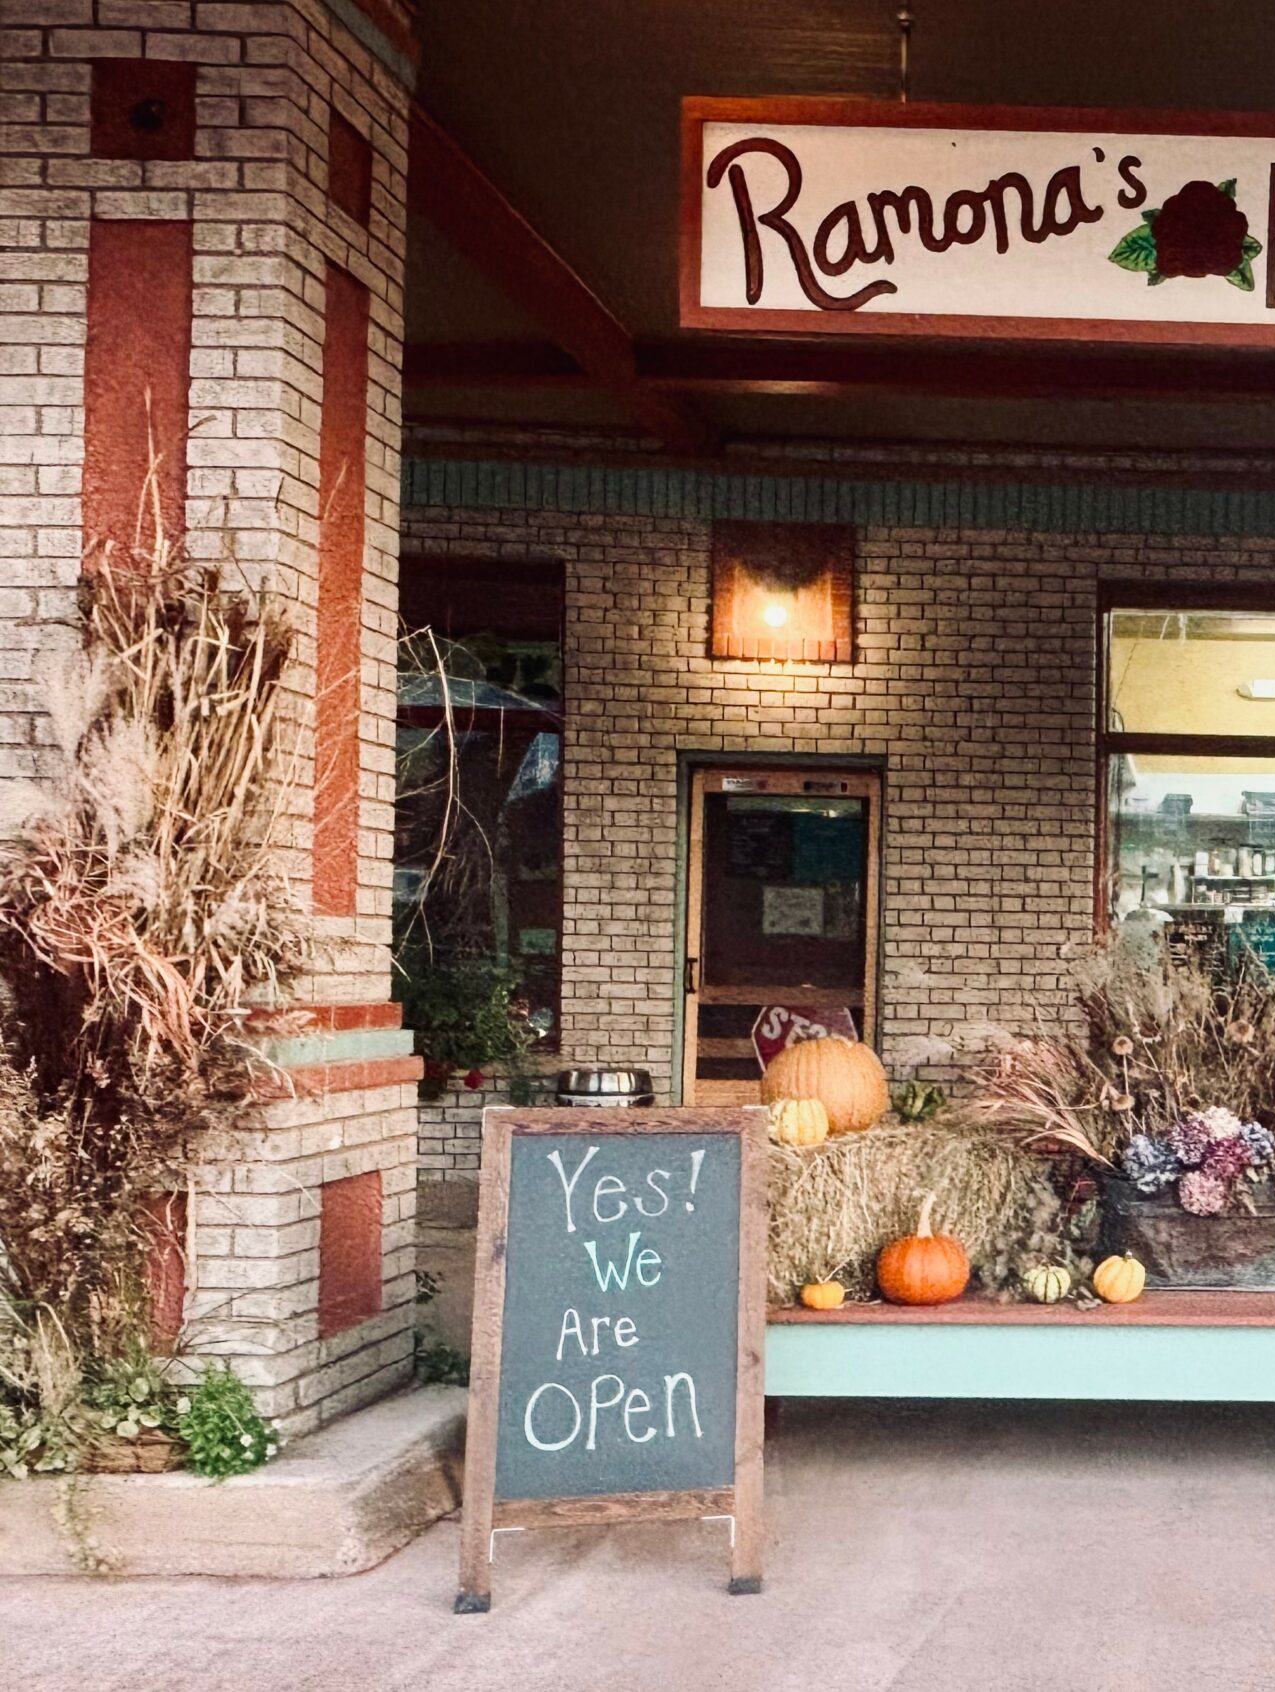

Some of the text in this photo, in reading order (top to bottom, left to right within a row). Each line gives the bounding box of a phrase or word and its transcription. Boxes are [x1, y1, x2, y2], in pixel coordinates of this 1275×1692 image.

[707, 136, 1149, 311] Ramona's
[547, 1146, 706, 1233] Yes!
[583, 1231, 662, 1292] We
[556, 1308, 640, 1361] Are
